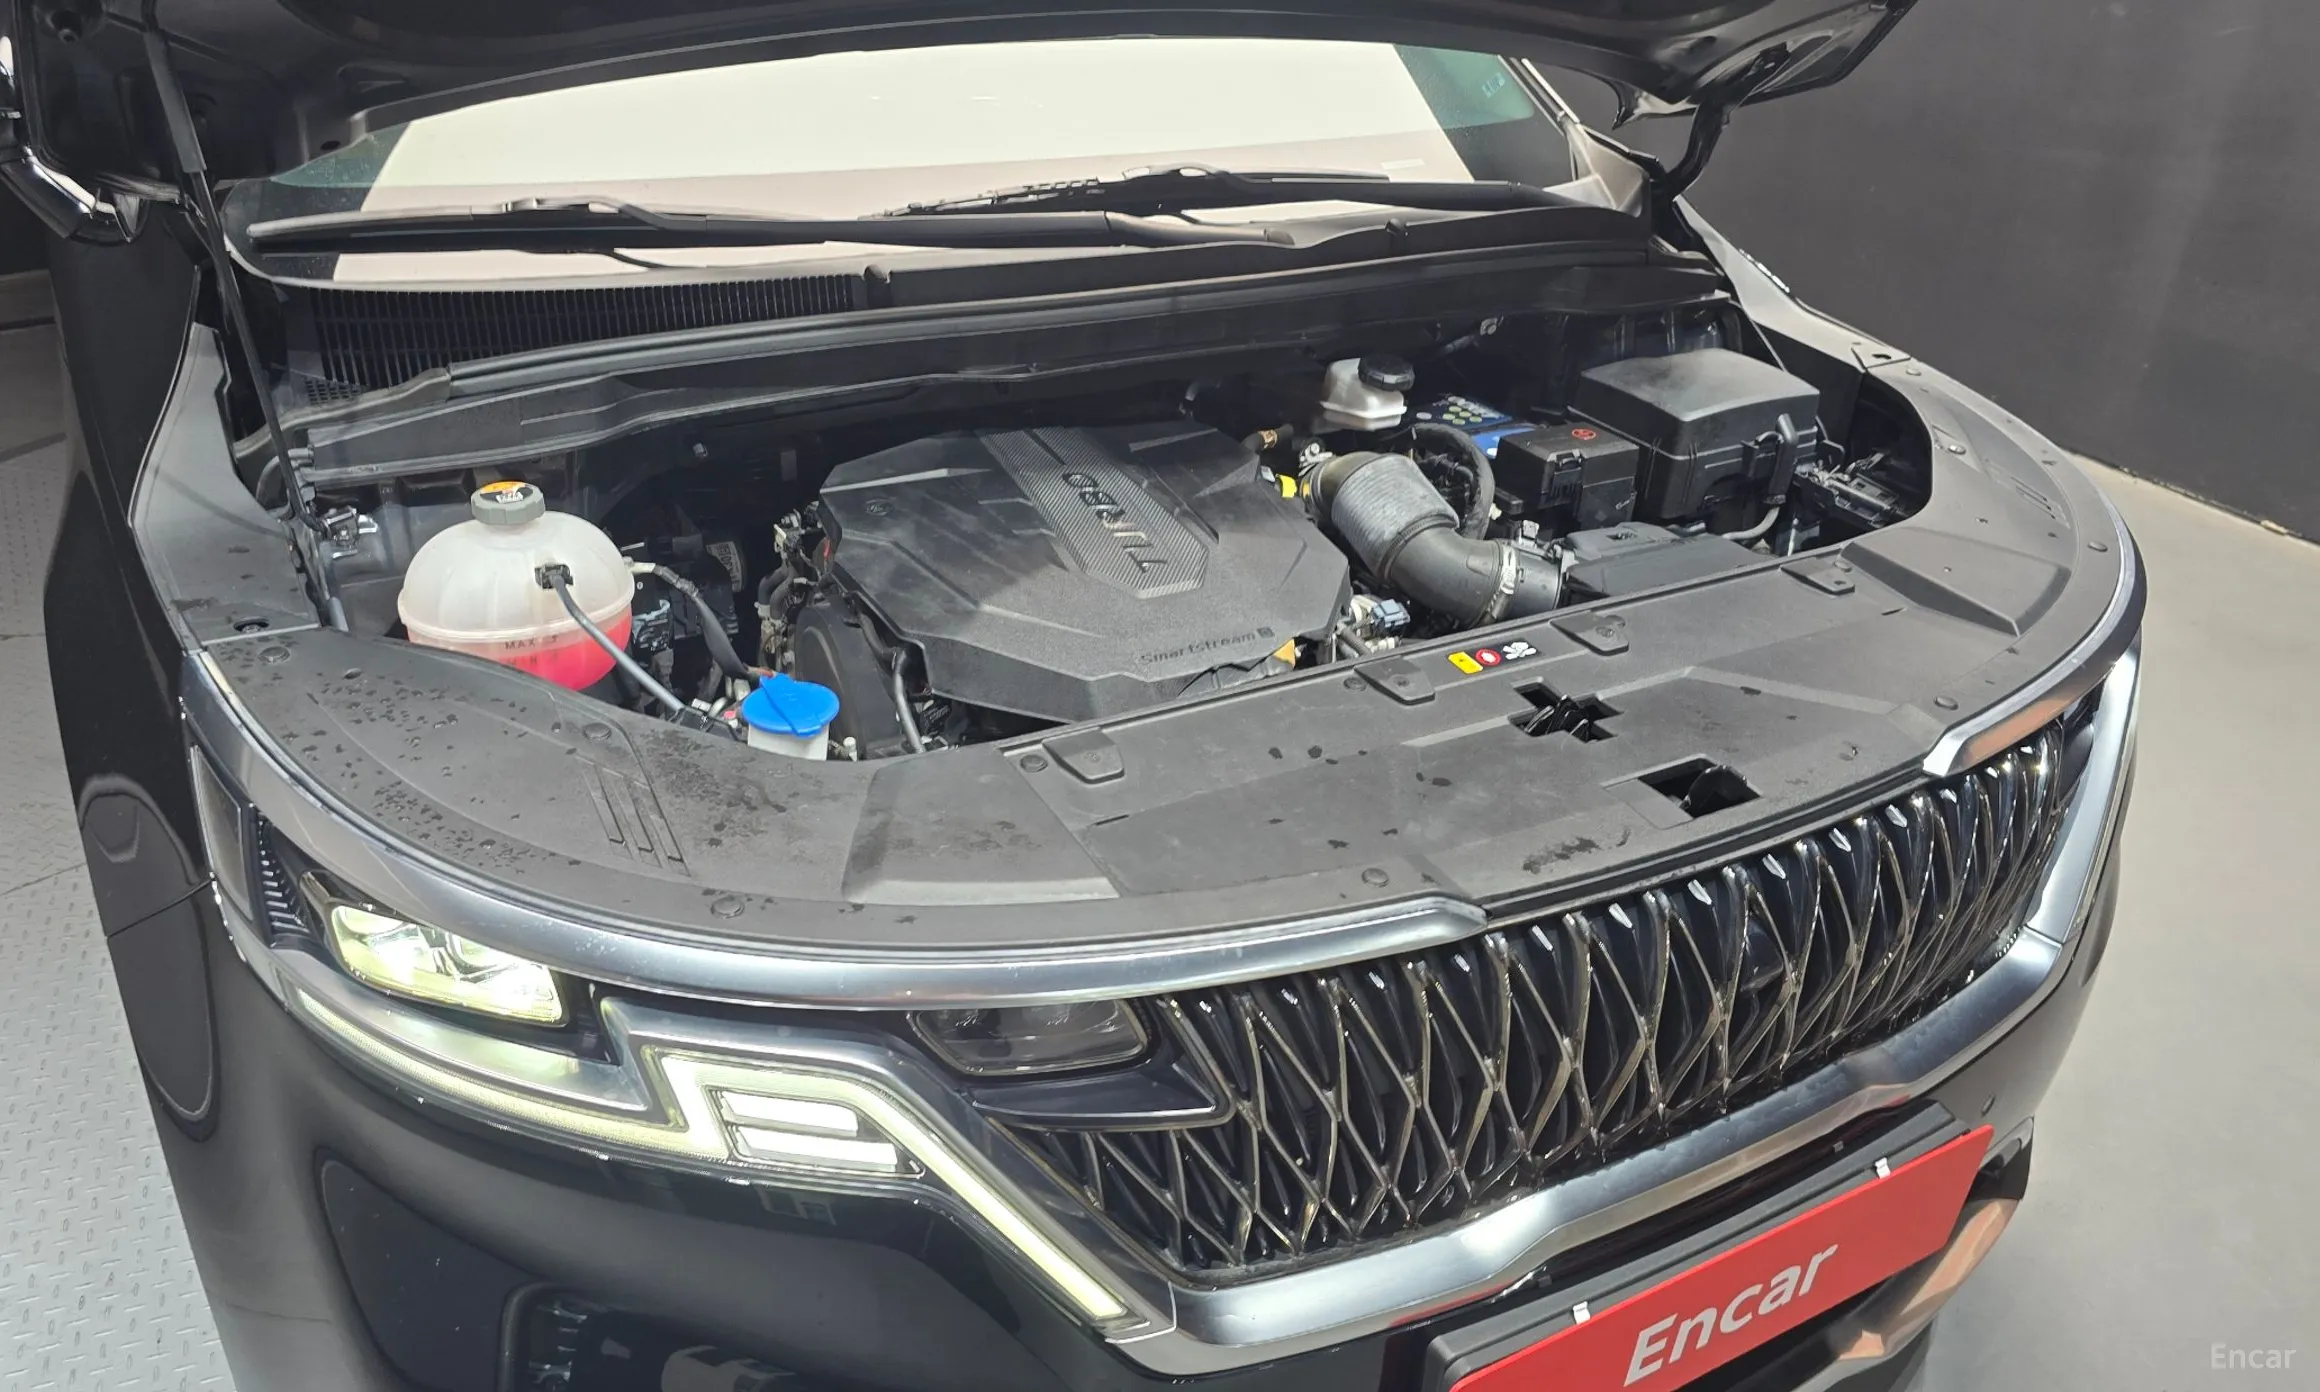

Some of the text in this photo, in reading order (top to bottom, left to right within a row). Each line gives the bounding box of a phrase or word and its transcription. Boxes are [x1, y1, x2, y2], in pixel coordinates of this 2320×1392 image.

[1062, 473, 1167, 573] TURBO
[505, 637, 536, 650] MAX
[1624, 1244, 1838, 1387] Encar
